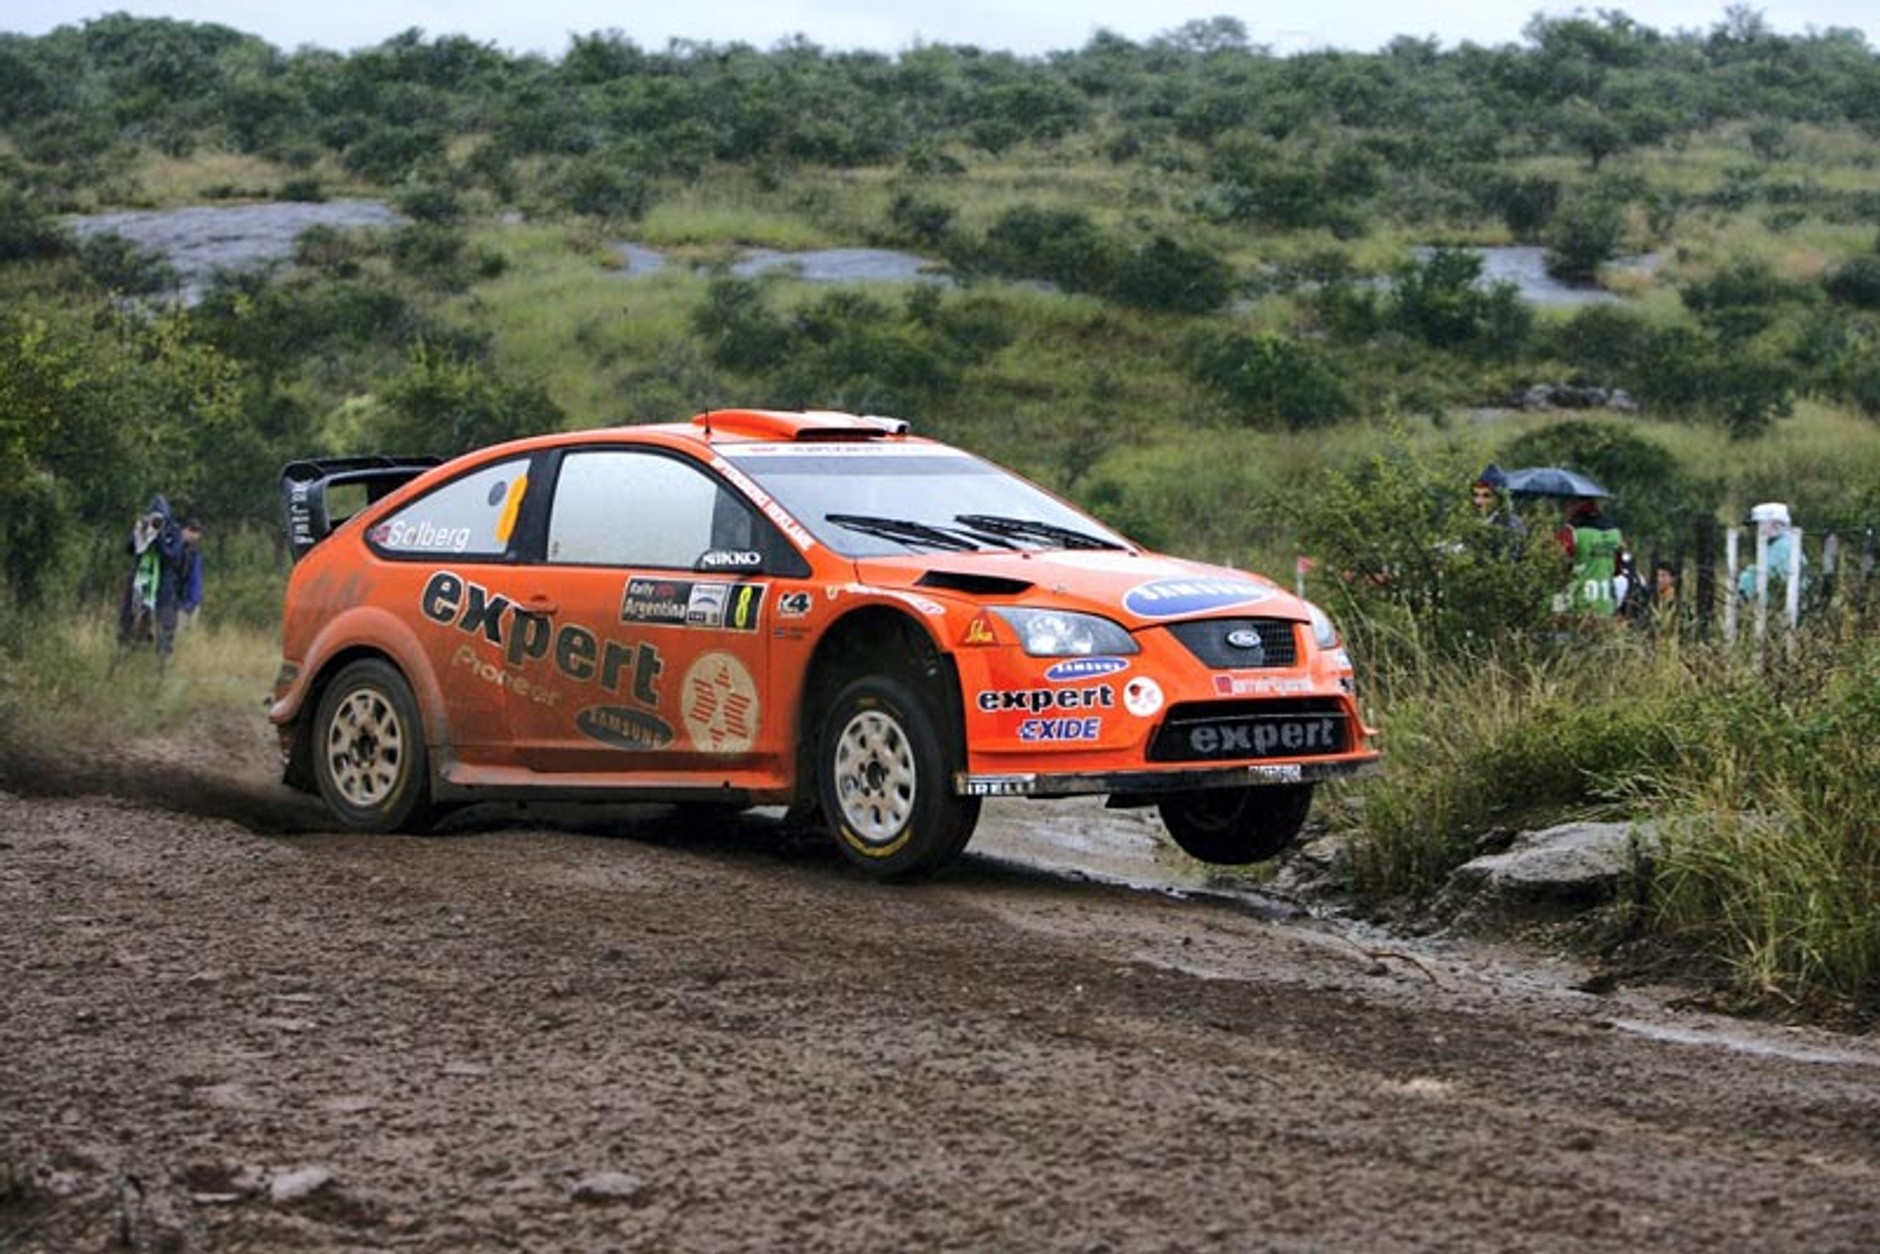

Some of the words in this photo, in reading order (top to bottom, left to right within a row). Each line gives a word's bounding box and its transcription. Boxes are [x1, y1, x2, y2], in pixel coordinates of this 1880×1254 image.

[389, 521, 471, 552] Solberg
[701, 551, 761, 566] NIKKO
[623, 597, 687, 619] Argentina
[735, 585, 753, 628] 8
[421, 570, 664, 708] expert
[979, 685, 1113, 713] expert
[1021, 720, 1098, 740] EXIDE
[1190, 717, 1335, 754] expert
